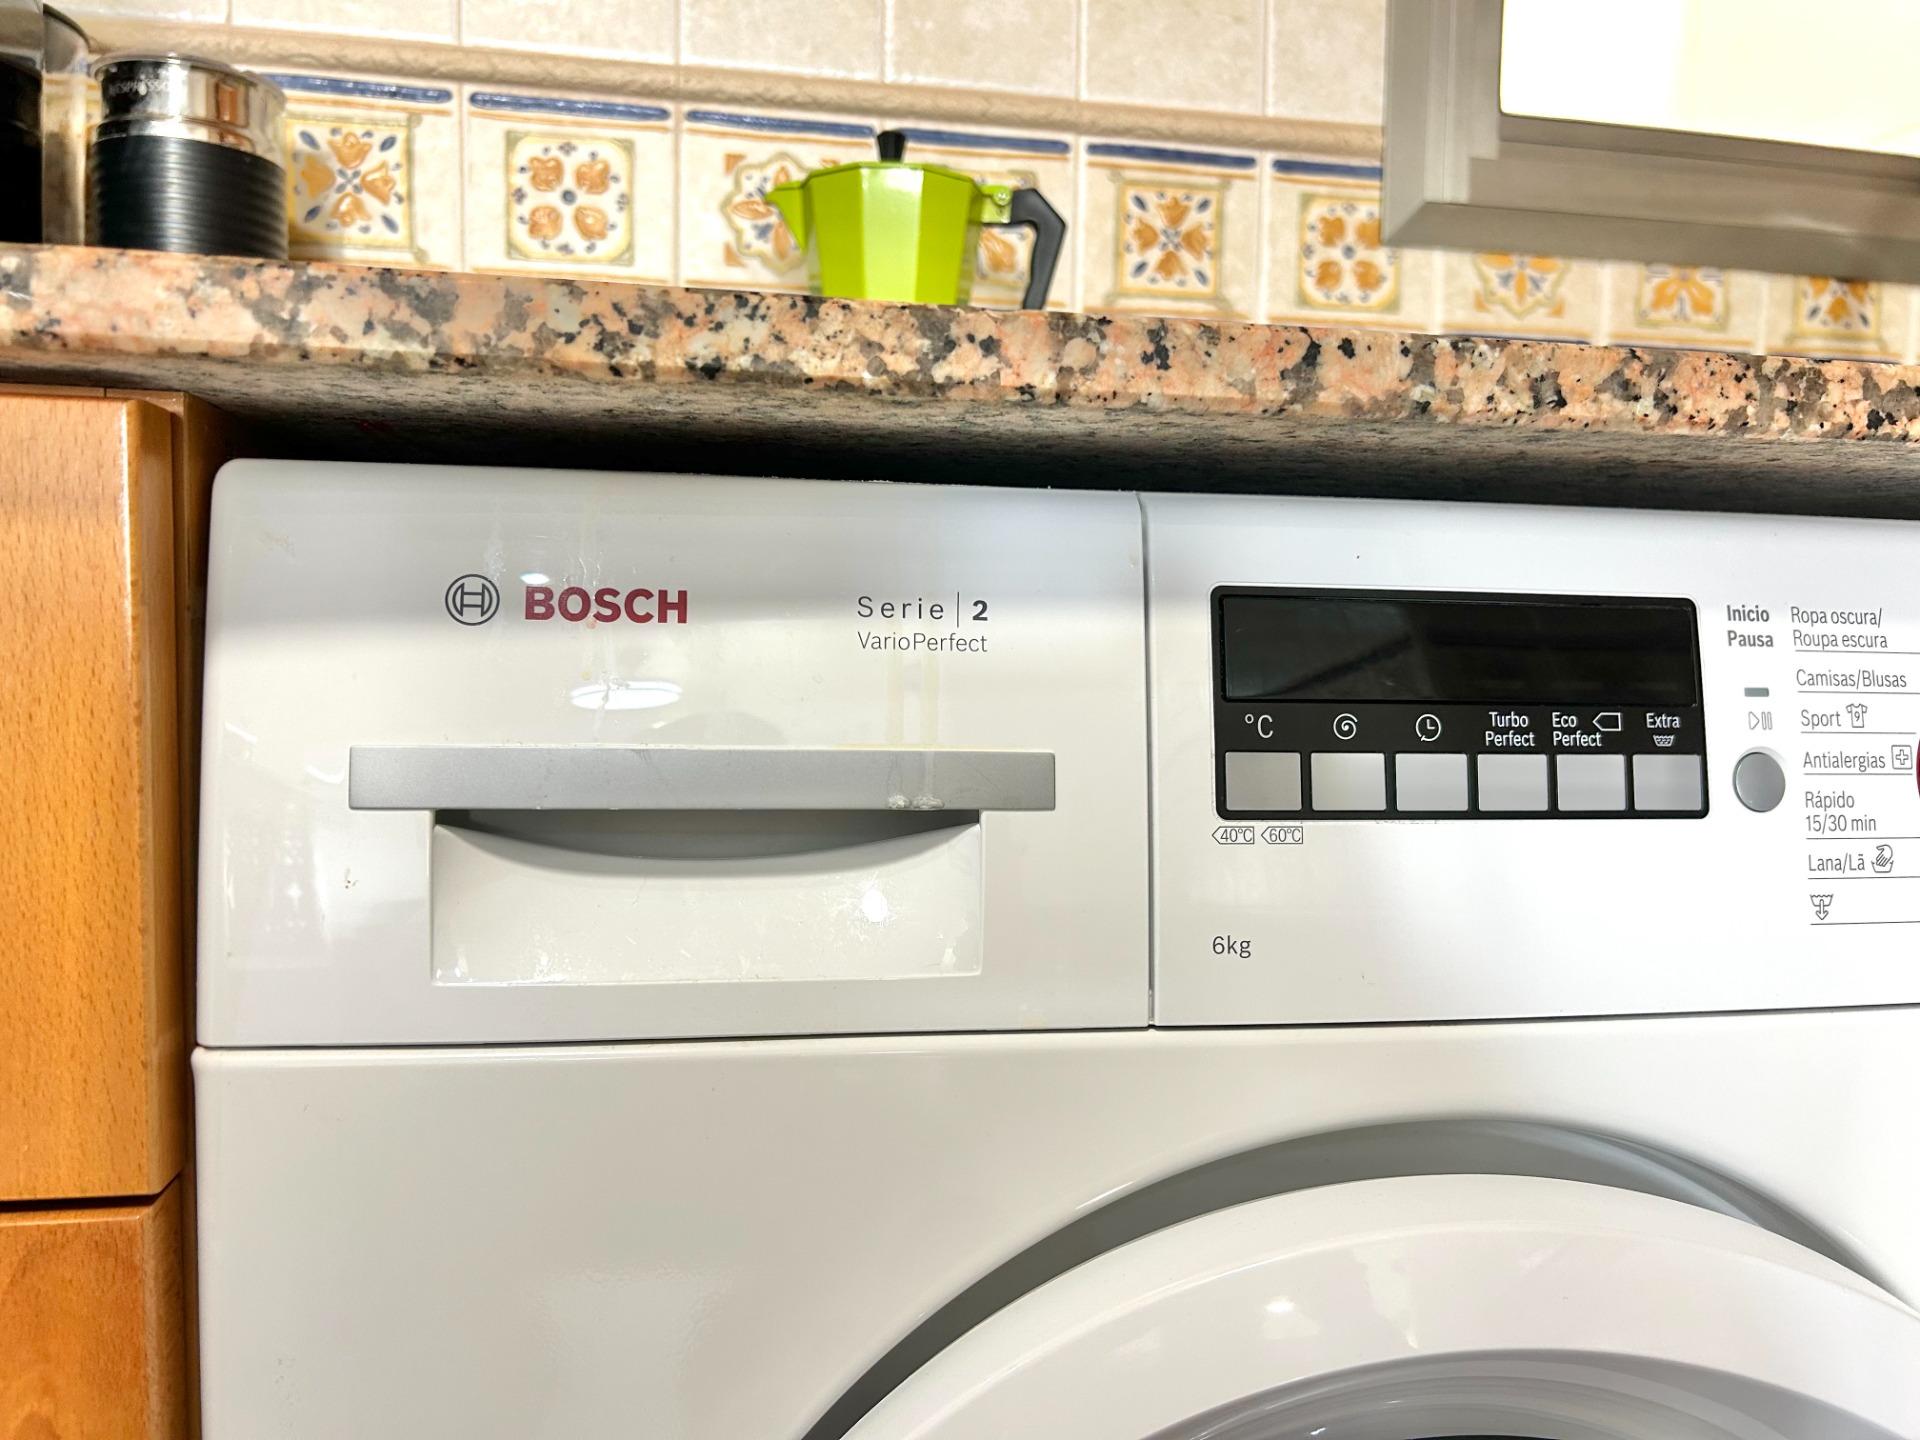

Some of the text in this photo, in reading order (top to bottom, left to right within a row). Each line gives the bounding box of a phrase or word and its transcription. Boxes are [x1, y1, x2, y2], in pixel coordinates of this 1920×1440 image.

[524, 585, 688, 624] BOSCH
[857, 595, 988, 621] Serie 2
[1726, 604, 1770, 622] Inicio
[1790, 606, 1883, 628] Ropa oscura/
[857, 631, 988, 653] VarioPerfect
[1727, 629, 1774, 648] Pausa
[1792, 629, 1889, 650] Roupa escura
[1796, 668, 1907, 690] Camisas/Blusas
[1488, 711, 1529, 728] Turbo
[1551, 711, 1578, 728] Eco
[1645, 712, 1681, 729] Extra
[1800, 708, 1842, 731] Sport
[1485, 730, 1535, 747] Perfect
[1552, 730, 1602, 747] Perfect
[1802, 750, 1886, 773] Antialergias
[1805, 790, 1855, 812] Rápido
[1805, 813, 1877, 835] 15/30 min
[1219, 828, 1253, 843] 40°C
[1268, 828, 1302, 843] 60°C
[1212, 934, 1252, 959] 6kg
